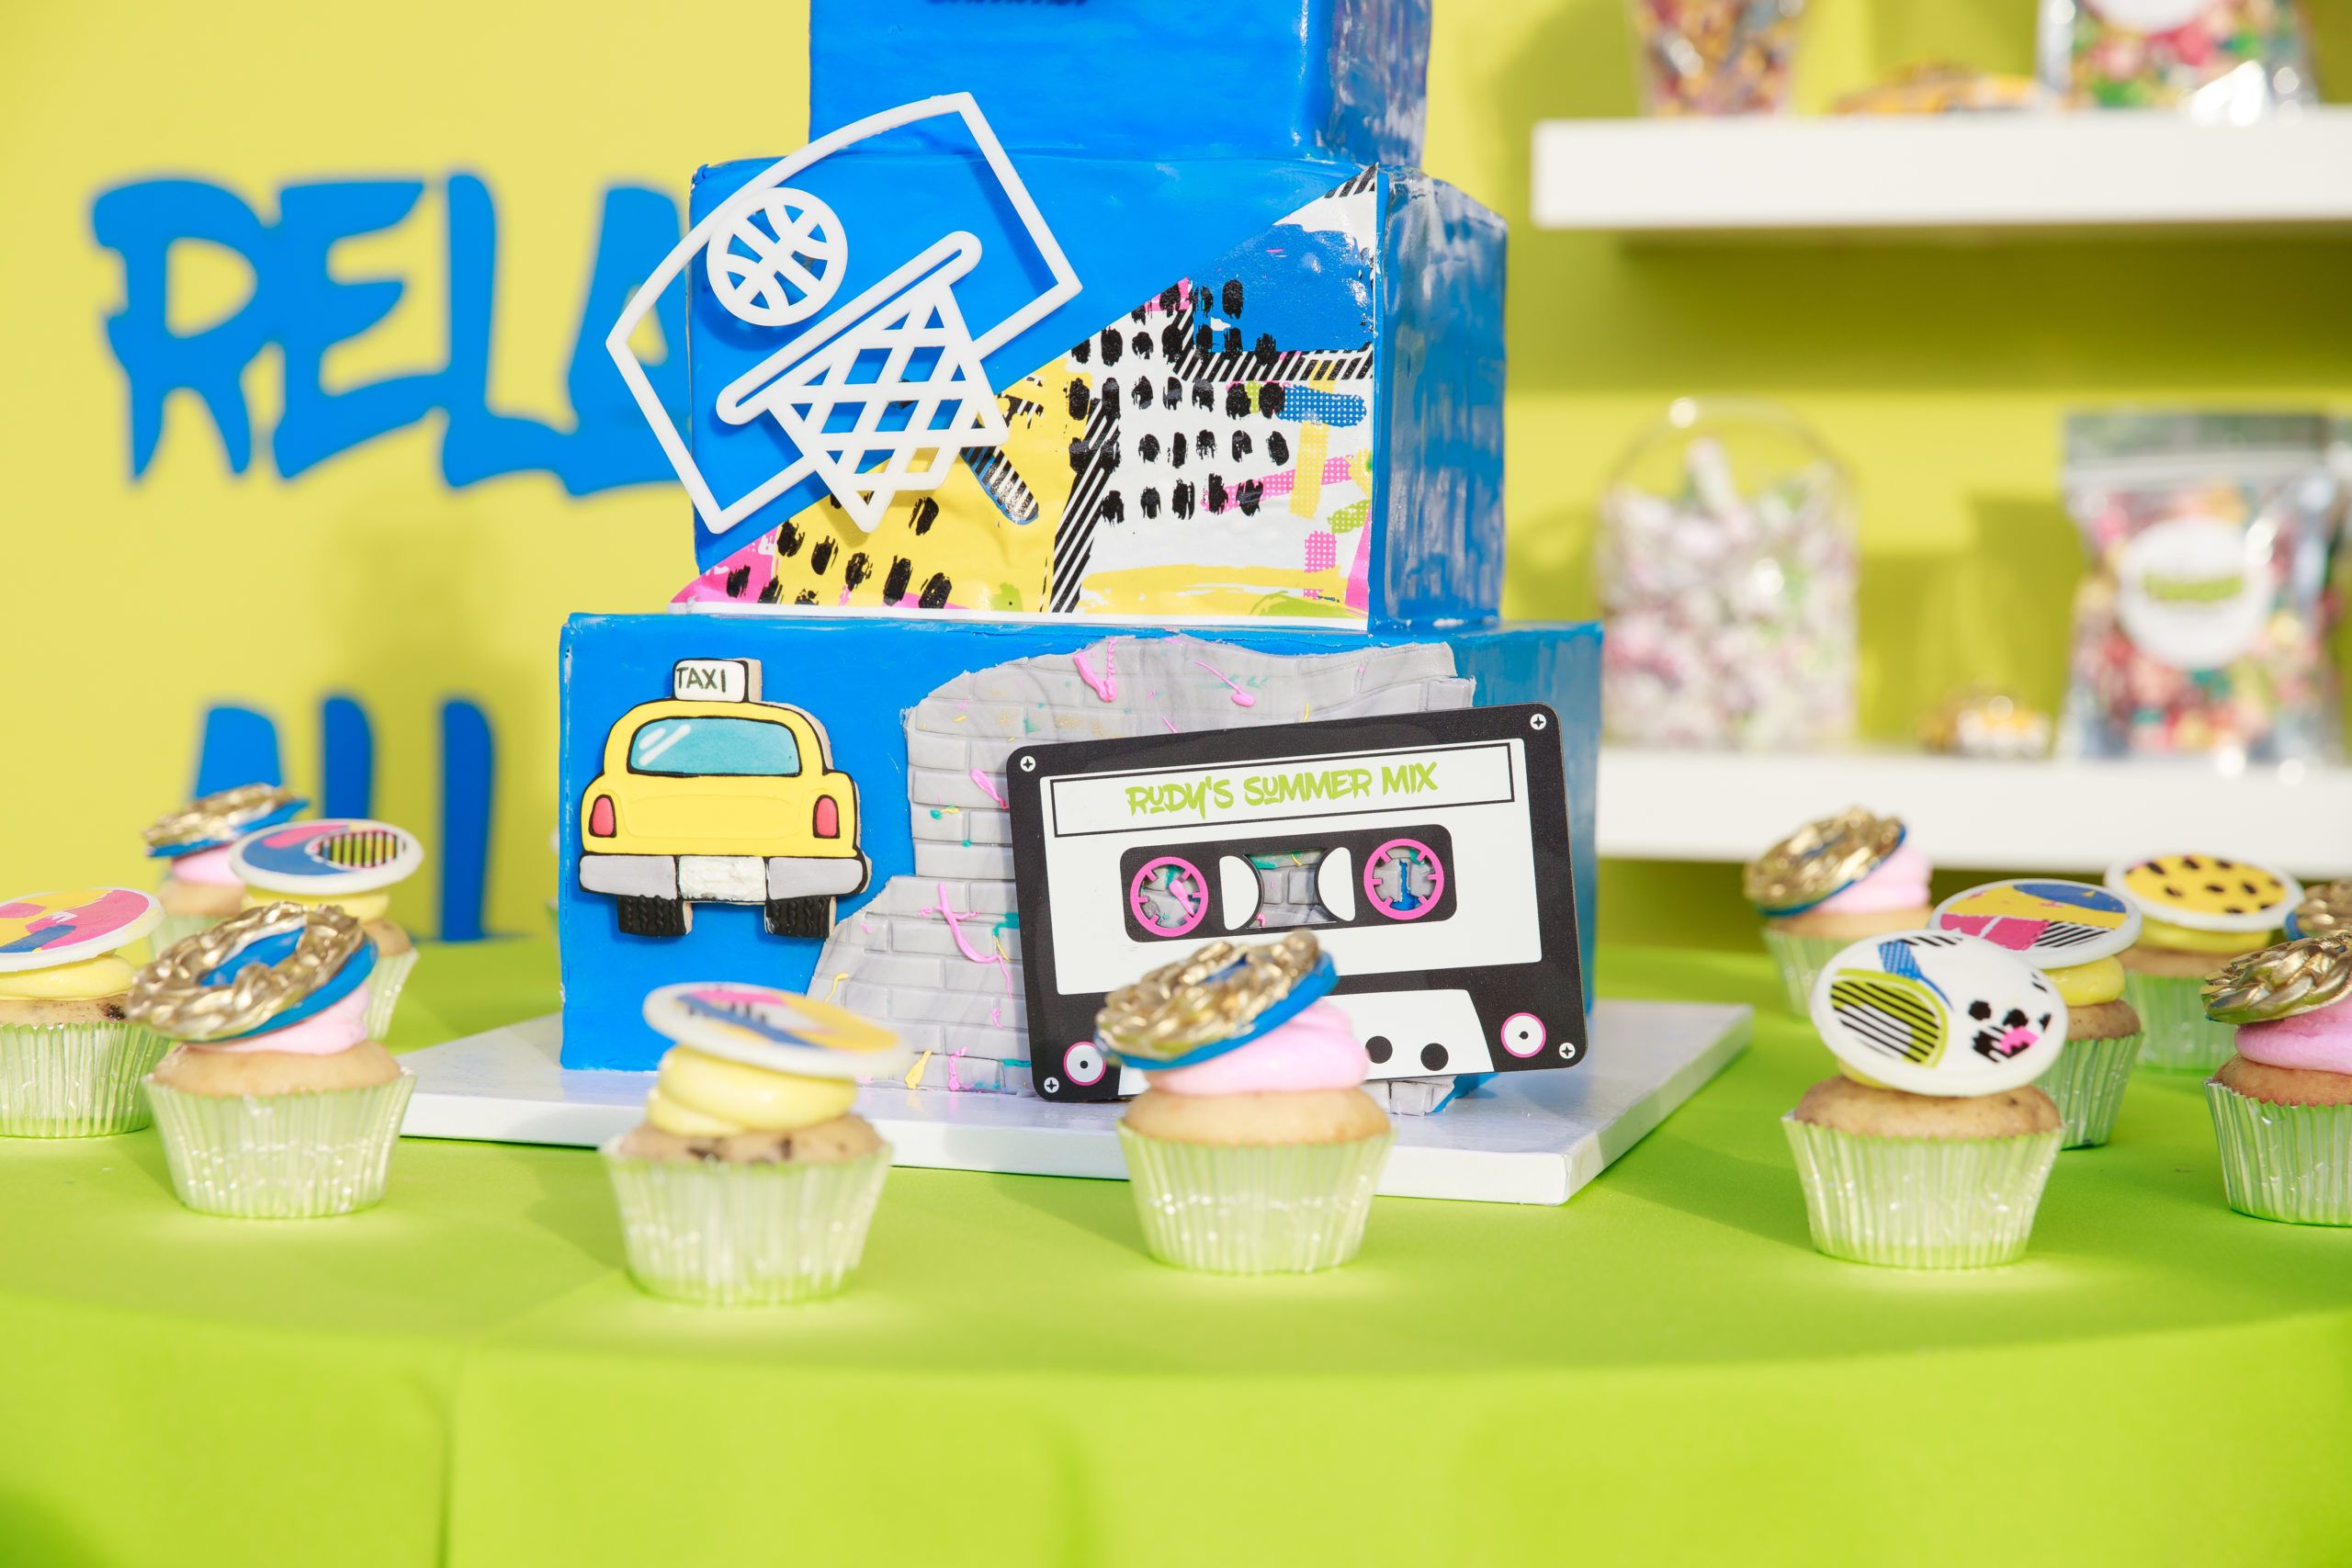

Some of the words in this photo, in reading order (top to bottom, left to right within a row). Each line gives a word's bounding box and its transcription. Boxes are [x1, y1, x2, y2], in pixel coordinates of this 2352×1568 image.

[676, 667, 726, 693] TAXI
[1124, 775, 1235, 820] RUDY'S
[1243, 767, 1374, 807] SUMMER
[1381, 761, 1439, 795] MIX
